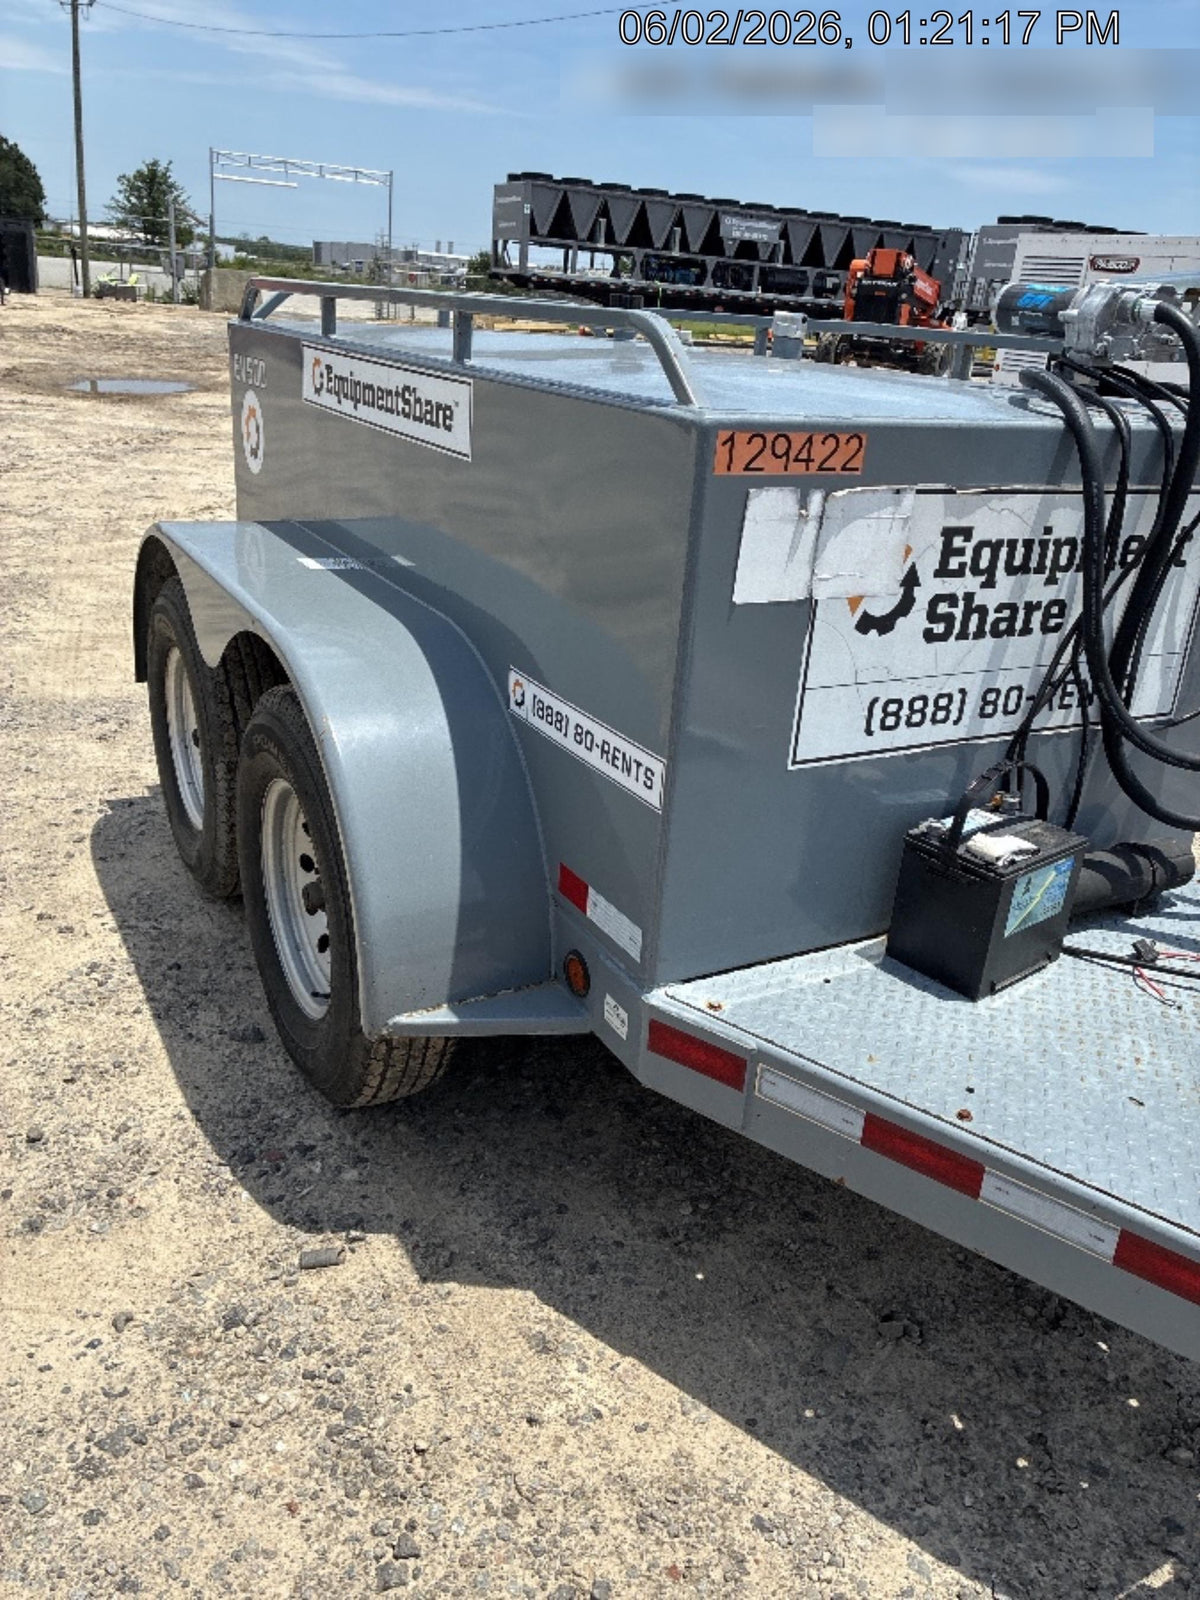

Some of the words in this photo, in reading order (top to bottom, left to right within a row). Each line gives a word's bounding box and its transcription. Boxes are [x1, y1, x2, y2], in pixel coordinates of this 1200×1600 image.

[720, 431, 863, 472] 129422
[921, 592, 1068, 644] Share
[864, 687, 968, 737] (888)
[532, 693, 570, 738] (888)
[573, 722, 656, 790] 80-RENTS
